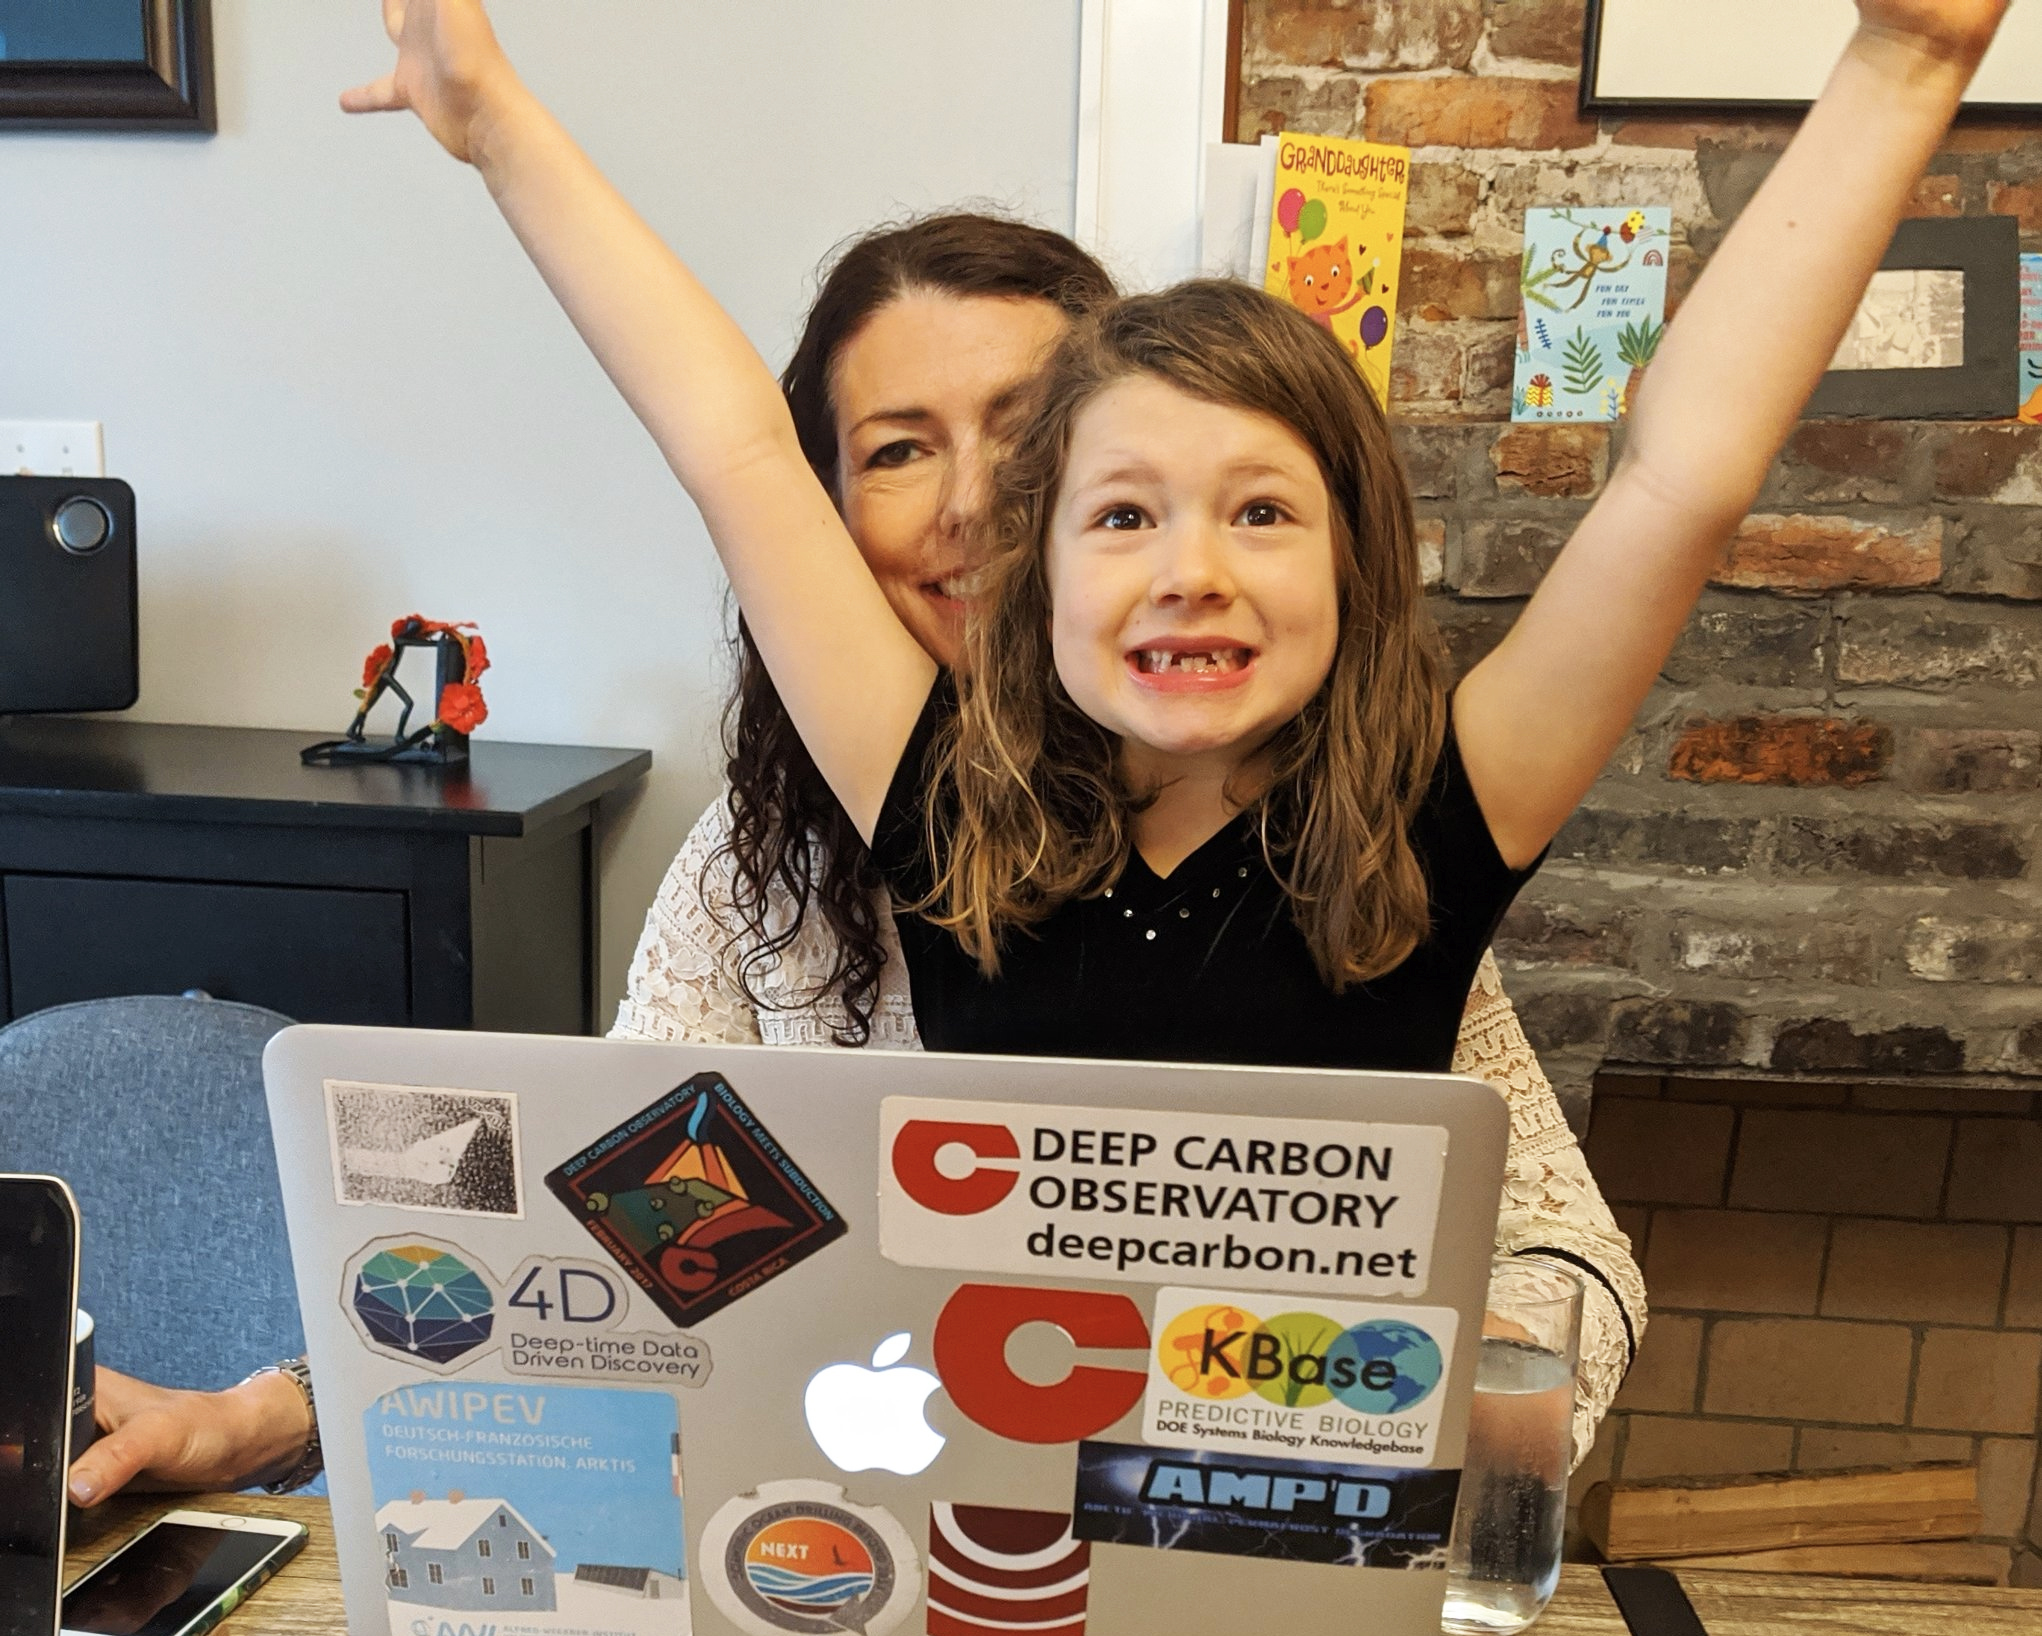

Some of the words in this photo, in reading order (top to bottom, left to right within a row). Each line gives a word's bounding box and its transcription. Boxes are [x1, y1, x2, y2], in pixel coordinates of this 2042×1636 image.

[627, 1084, 696, 1133] OBSERVATORY
[714, 1082, 755, 1128] BIOLOGY
[751, 1127, 781, 1160] MEETS
[778, 1159, 834, 1221] SUBDUCTION
[1033, 1128, 1157, 1167] DEEP
[1174, 1136, 1393, 1182] CARBON
[1029, 1175, 1400, 1229] OBSERVATORY
[1027, 1223, 1417, 1279] deepcarbon.net
[508, 1266, 616, 1323] 4D
[511, 1333, 635, 1355] Deep-time
[643, 1340, 699, 1359] Data
[513, 1350, 584, 1369] Driven
[591, 1354, 701, 1379] Discovery
[1199, 1327, 1396, 1392] KBase
[379, 1388, 547, 1426] AWIPEV
[1158, 1400, 1305, 1430] PREDICTIVE
[1318, 1415, 1429, 1440] BIOLOGY
[1156, 1420, 1188, 1433] DOE
[1192, 1423, 1247, 1440] Systems
[1252, 1429, 1306, 1448] Biology
[1310, 1434, 1425, 1455] Knowledgebase
[575, 1457, 636, 1473] ARKTIS
[1147, 1465, 1391, 1519] AMP'D
[760, 1541, 810, 1560] NEXT
